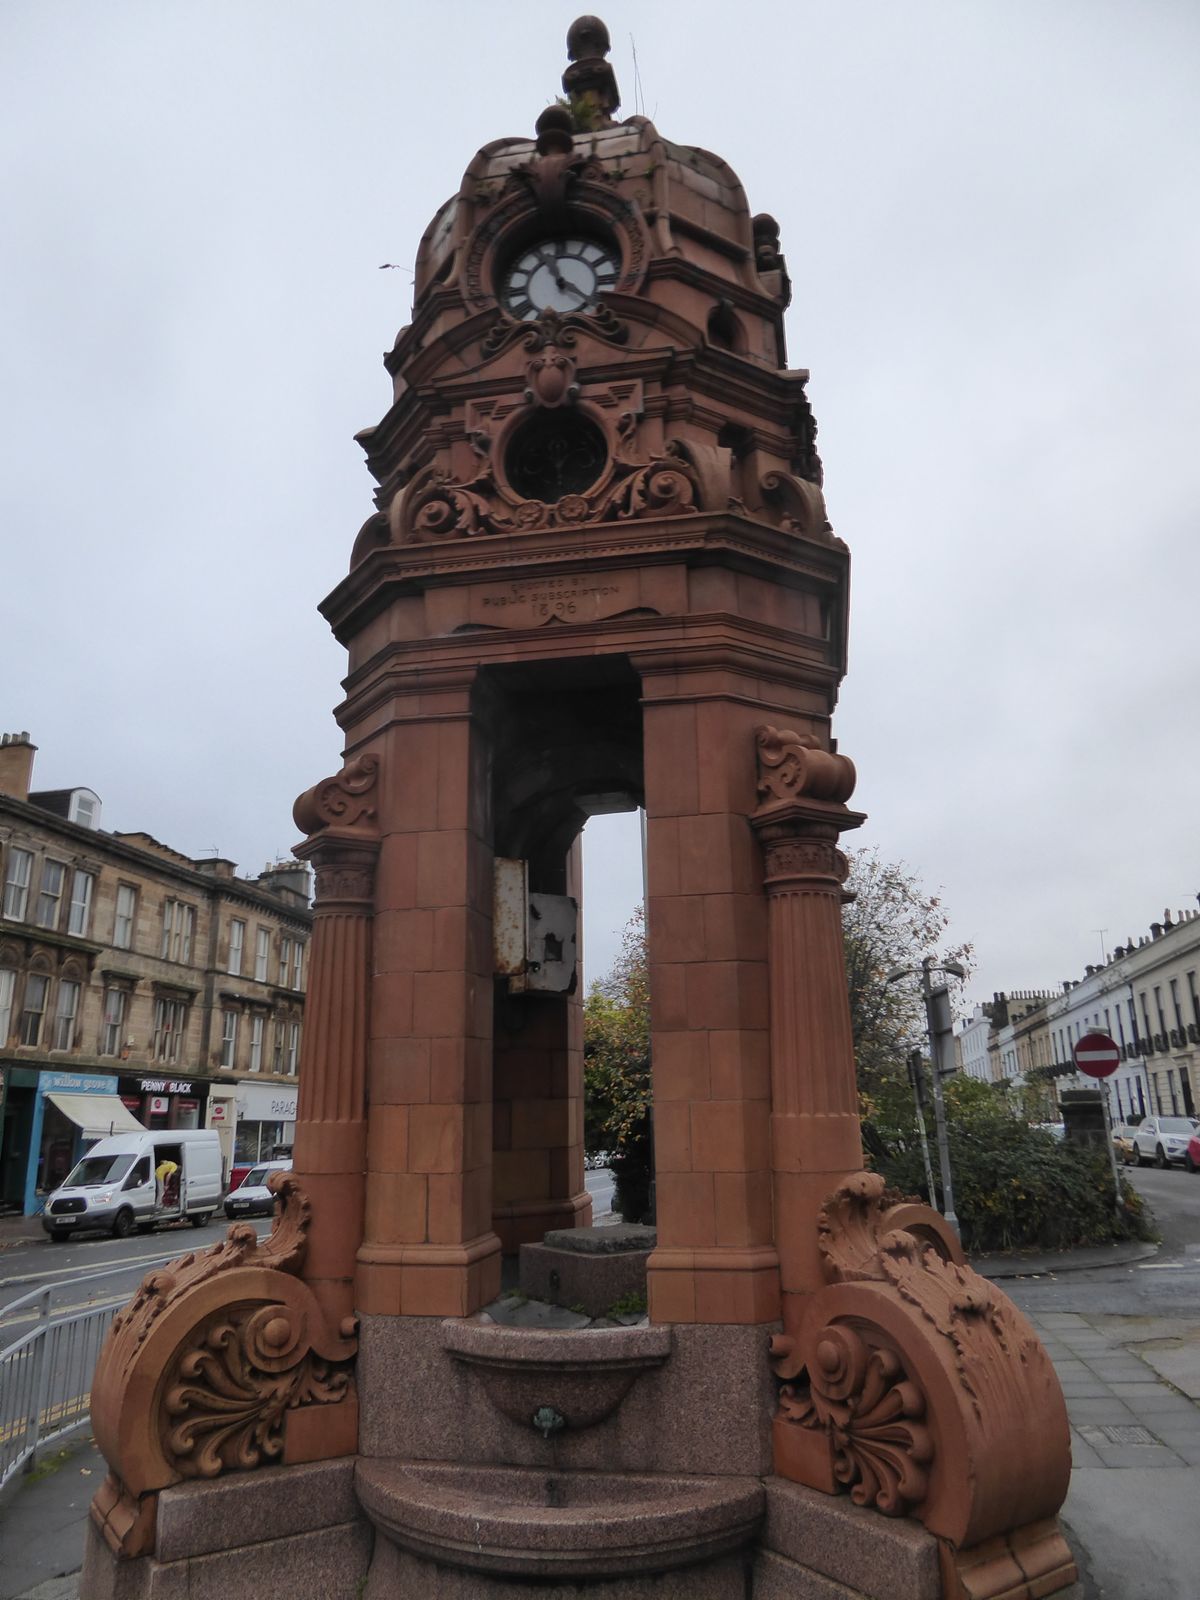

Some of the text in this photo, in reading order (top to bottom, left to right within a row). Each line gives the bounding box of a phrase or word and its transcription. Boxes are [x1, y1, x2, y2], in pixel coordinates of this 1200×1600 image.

[482, 586, 620, 607] PUBLIC SUBSCRIPTION
[531, 601, 576, 617] 1896
[141, 1080, 192, 1093] PENNY BLACK
